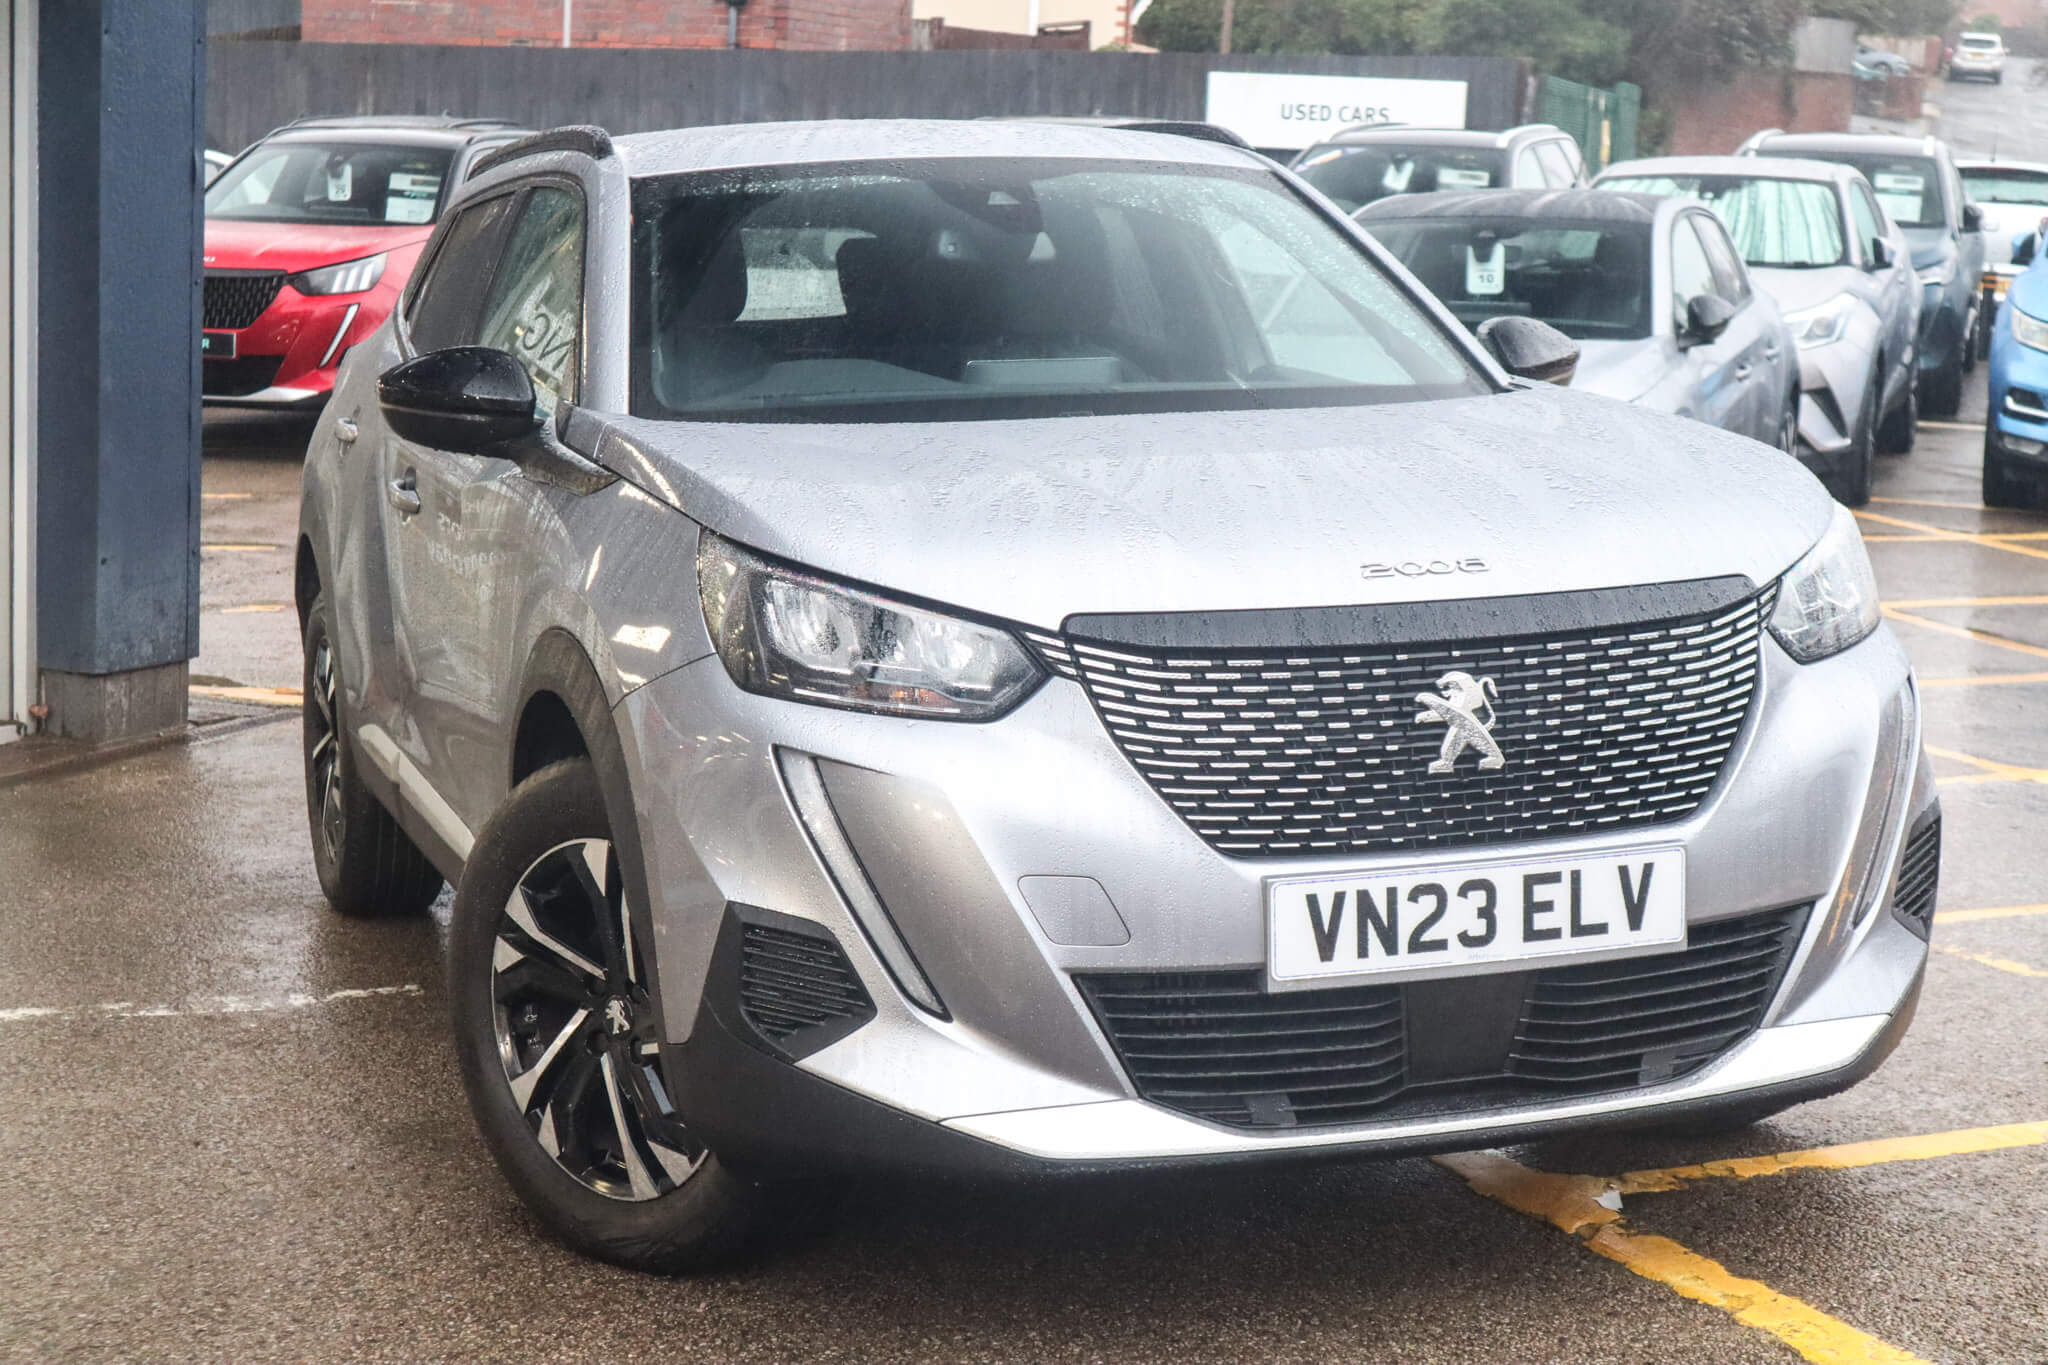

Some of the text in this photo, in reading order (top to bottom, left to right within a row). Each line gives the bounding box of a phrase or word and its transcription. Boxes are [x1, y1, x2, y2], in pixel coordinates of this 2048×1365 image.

[1281, 104, 1390, 123] USED CARS
[1360, 559, 1490, 579] 2008
[1306, 862, 1655, 962] VN23 ELV
